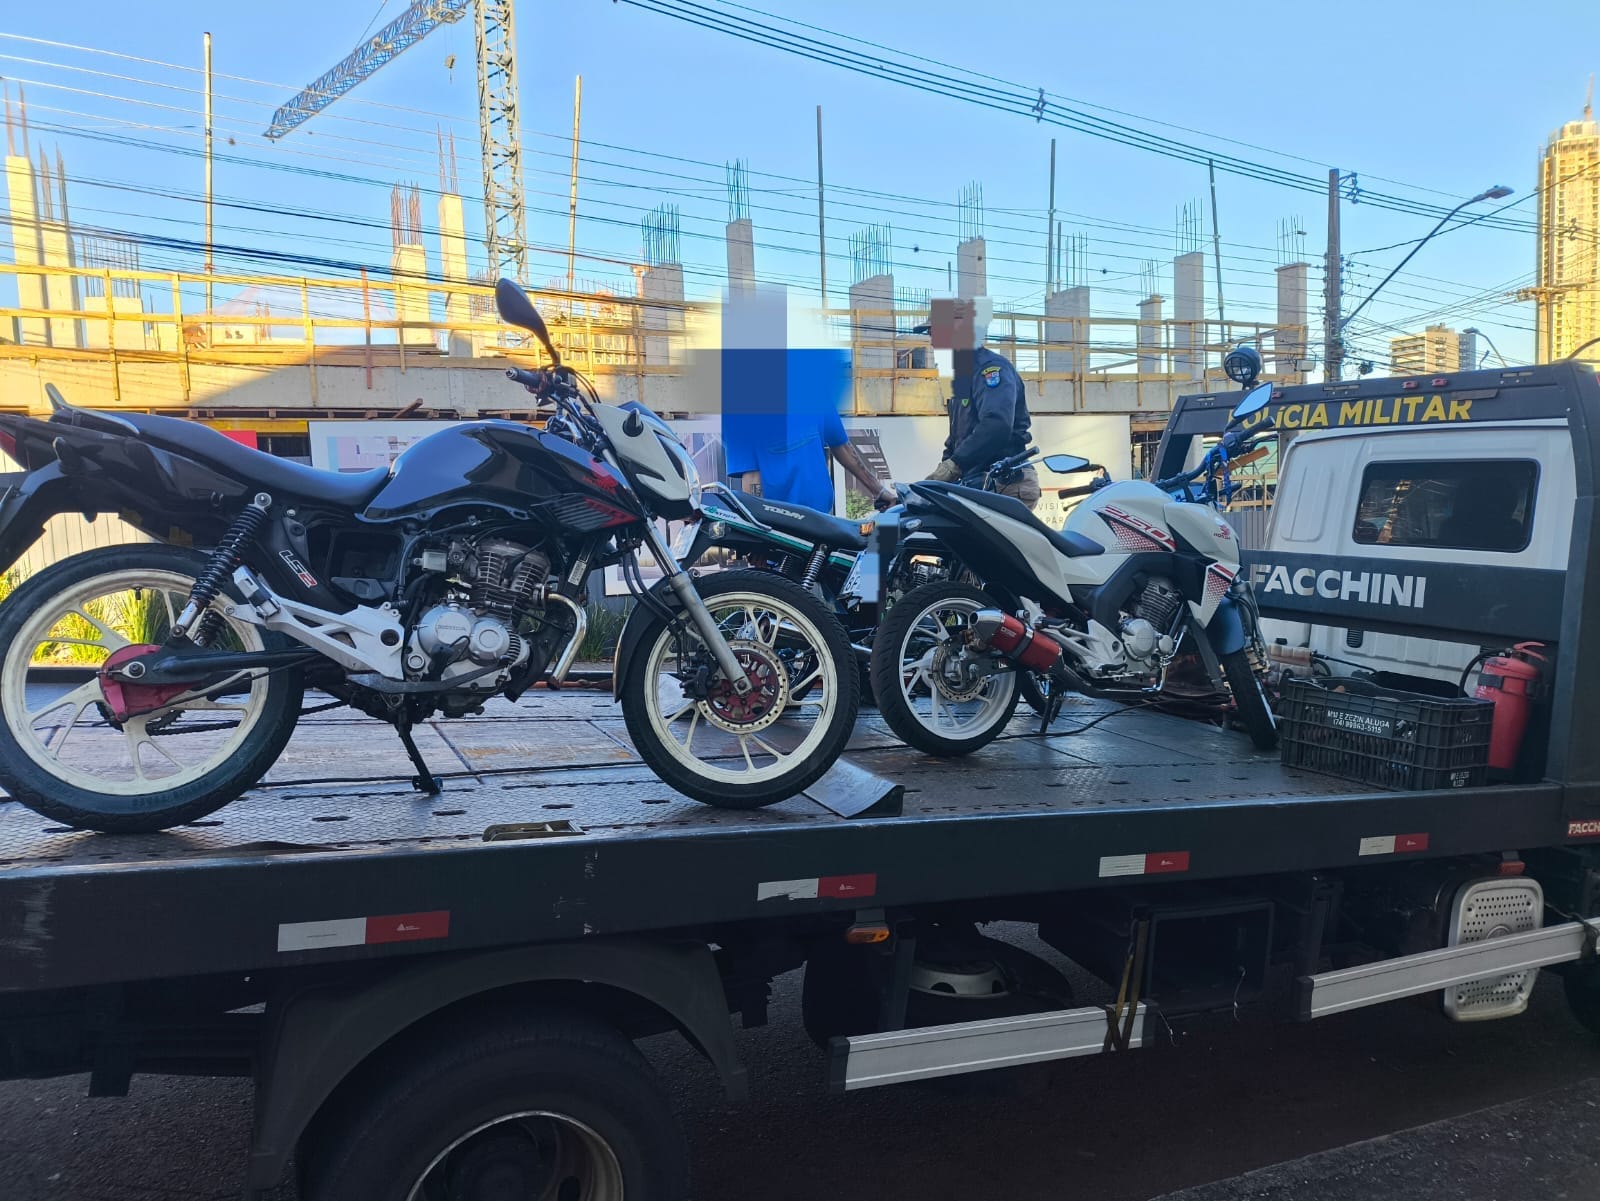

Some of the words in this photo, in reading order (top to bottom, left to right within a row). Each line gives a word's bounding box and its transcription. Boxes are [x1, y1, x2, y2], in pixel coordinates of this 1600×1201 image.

[1228, 402, 1329, 429] OÍCIA
[1338, 395, 1473, 426] MILITAR
[1038, 502, 1072, 510] VISIT
[278, 549, 318, 588] LS2
[1249, 563, 1427, 609] FACCHINI
[1365, 717, 1390, 728] ALUGA
